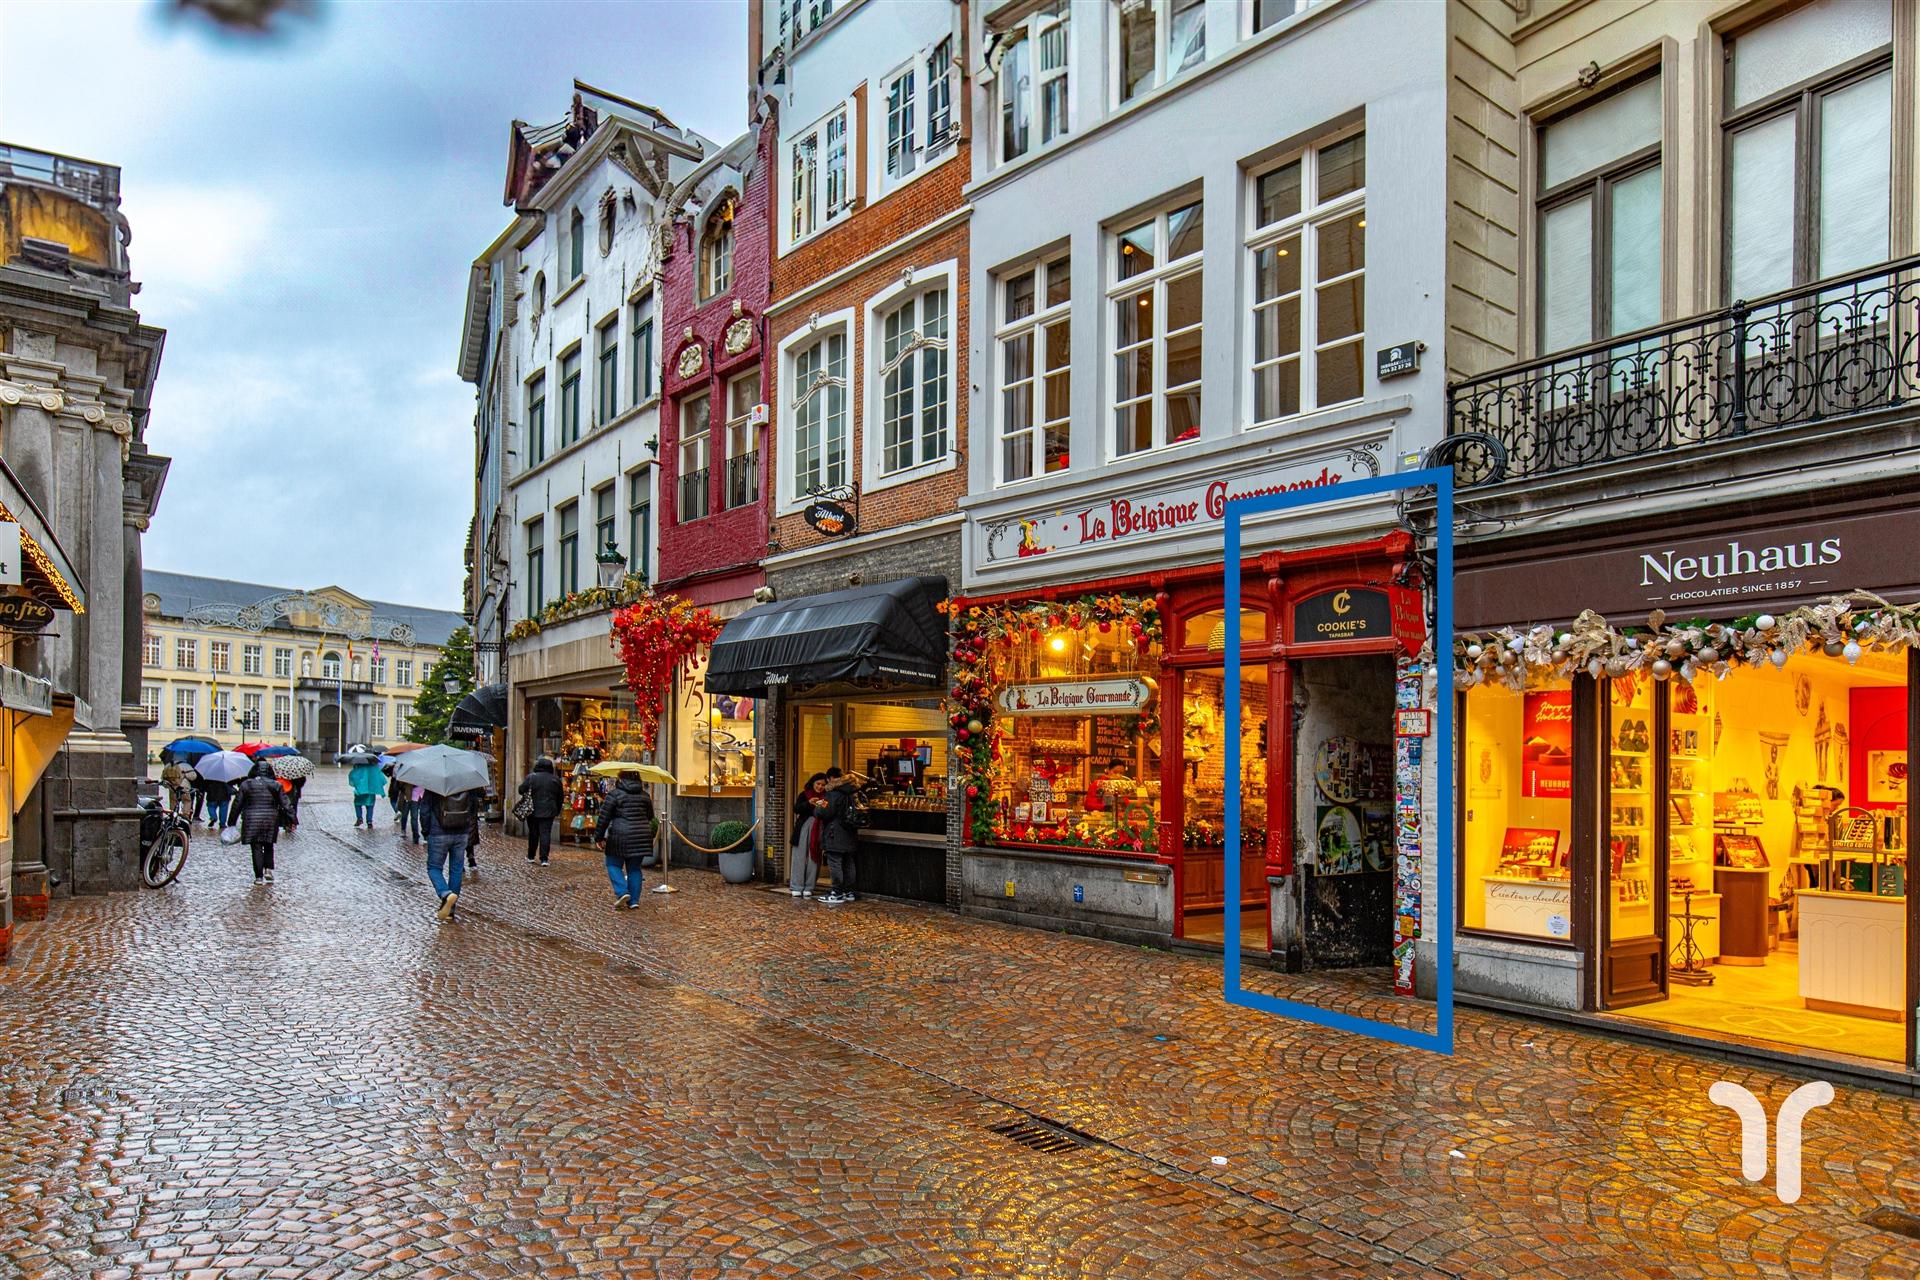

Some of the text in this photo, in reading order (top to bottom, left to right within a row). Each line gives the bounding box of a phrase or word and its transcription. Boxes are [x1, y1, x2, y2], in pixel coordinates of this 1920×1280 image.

[815, 509, 845, 522] Albert
[1078, 499, 1199, 543] La Belgique
[1640, 537, 1842, 586] Neuhaus
[1669, 580, 1802, 601] CHOCOLATIER SINCE 1857
[1317, 620, 1366, 632] COOKIE'S
[1036, 686, 1131, 707] La Belgique Gourmande
[1540, 780, 1571, 789] NEUHAUS
